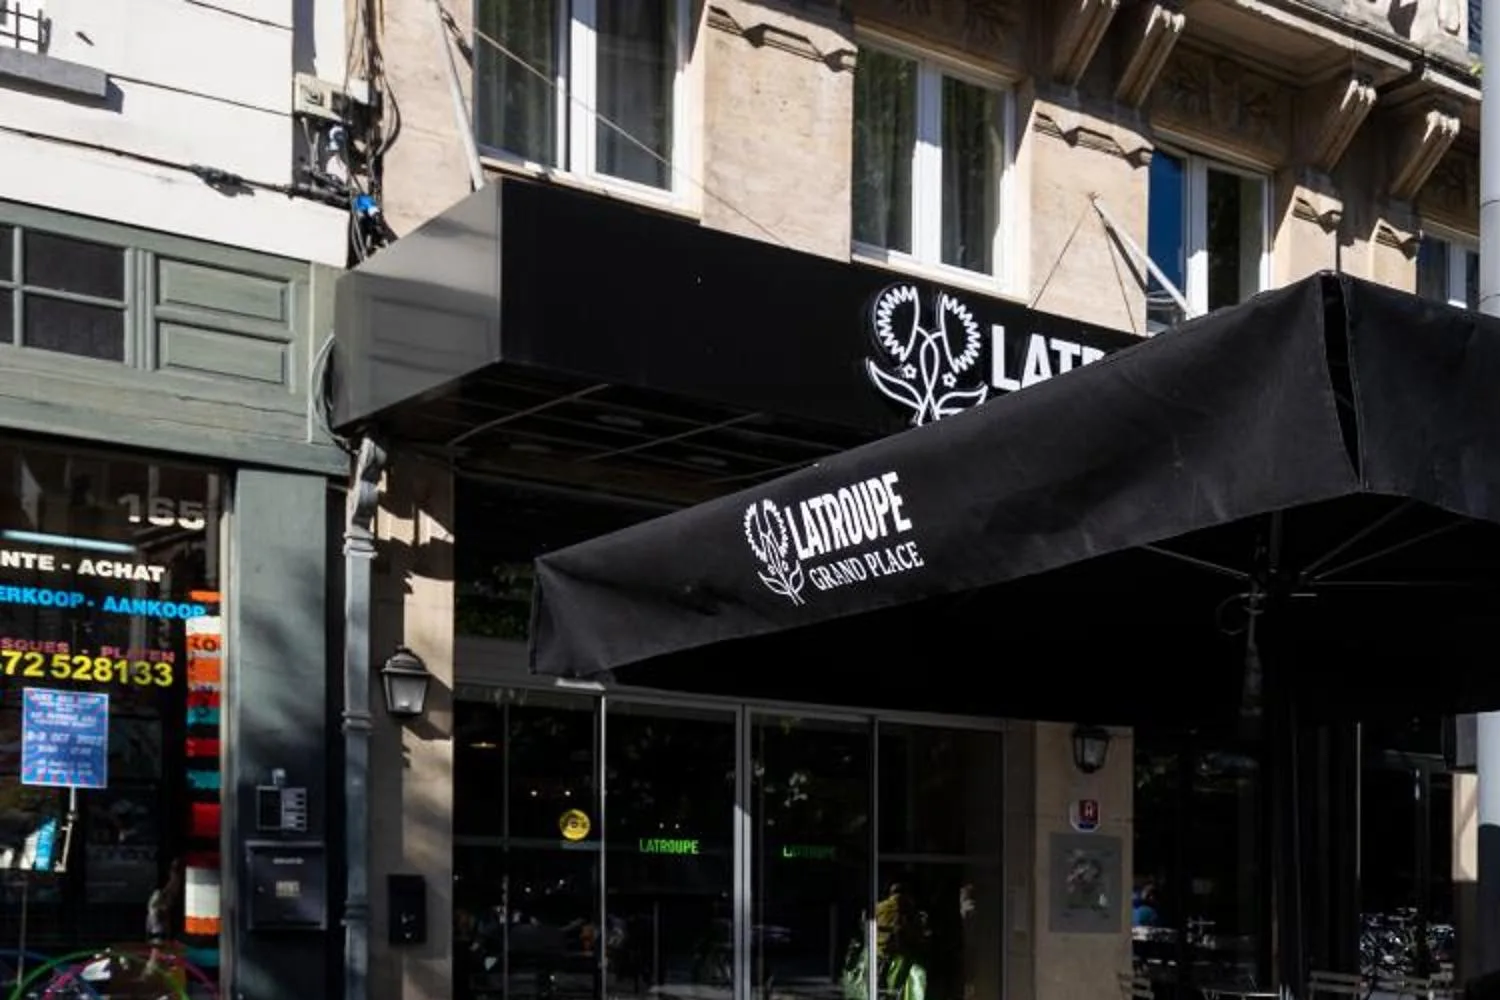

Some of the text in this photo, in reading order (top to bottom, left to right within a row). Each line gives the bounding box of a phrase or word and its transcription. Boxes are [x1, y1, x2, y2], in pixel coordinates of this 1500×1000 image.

[117, 493, 205, 530] 165
[784, 471, 912, 560] LATROUPE
[0, 550, 55, 571] NTE
[77, 558, 165, 582] ACHAT
[808, 540, 925, 591] GRAND PLACE
[103, 595, 206, 619] AANKOOP
[0, 649, 174, 687] 72 528133
